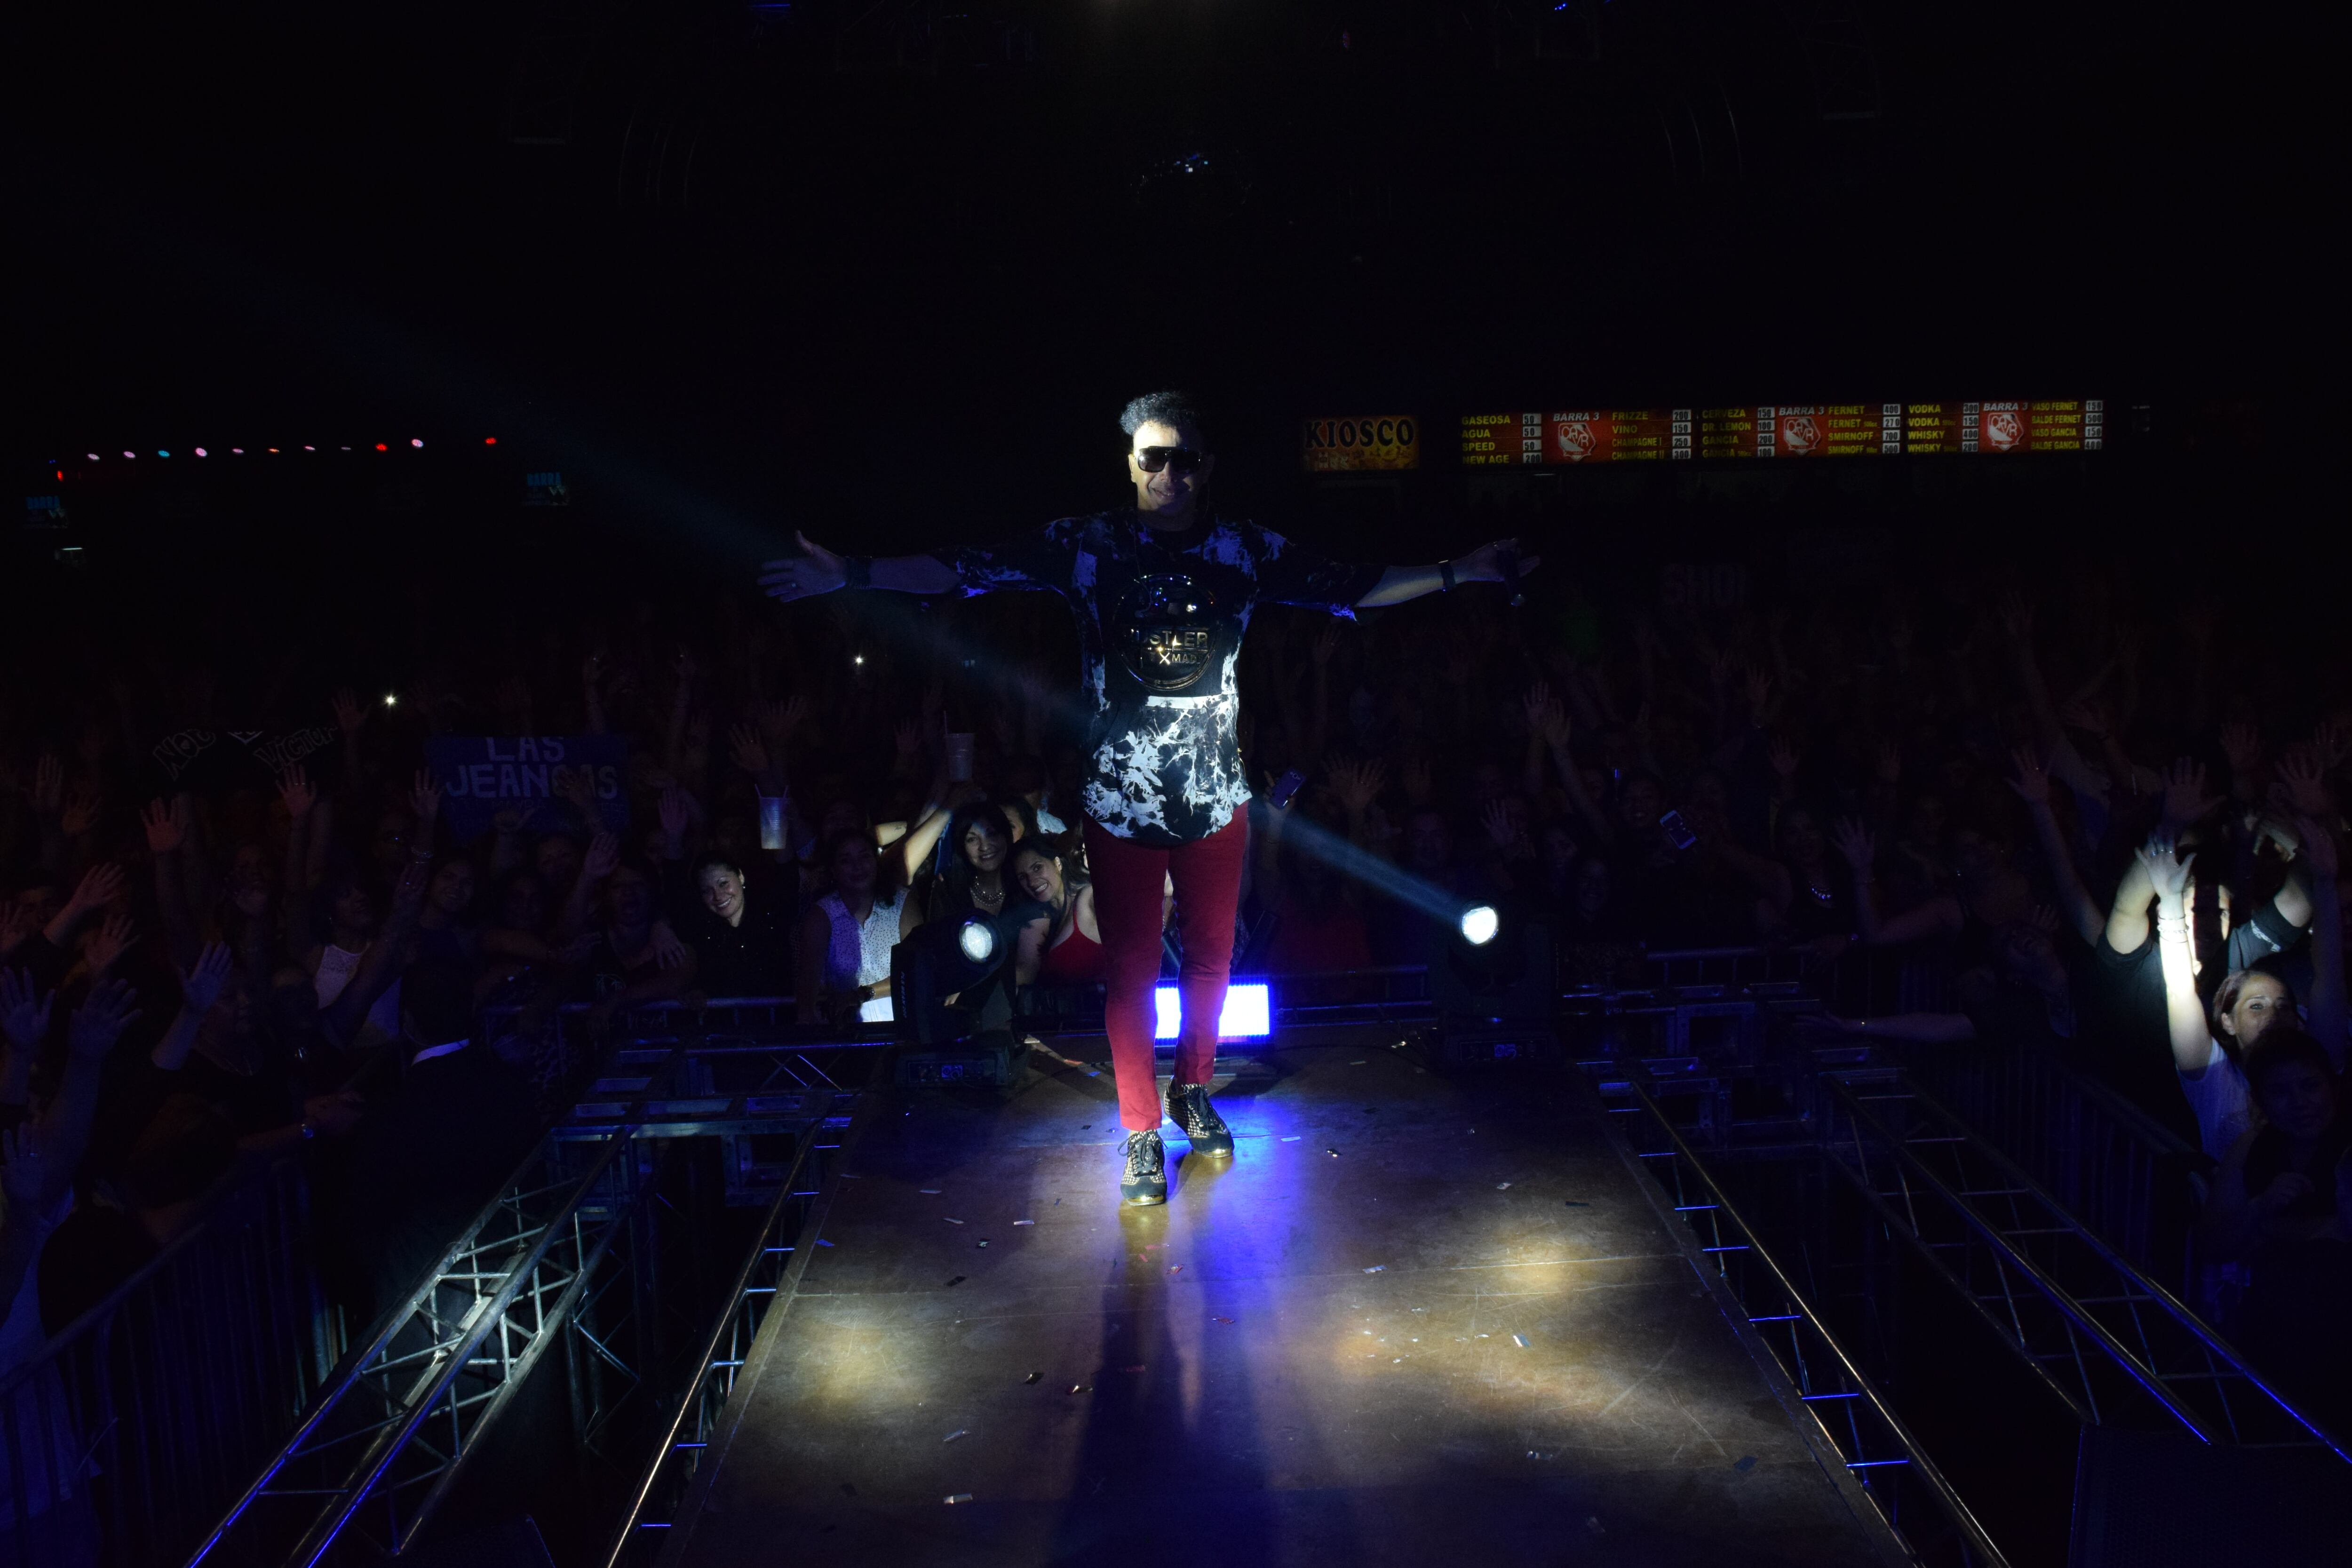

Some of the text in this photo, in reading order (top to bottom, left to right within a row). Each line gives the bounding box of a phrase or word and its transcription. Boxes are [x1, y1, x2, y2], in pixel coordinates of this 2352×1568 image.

[1828, 405, 1899, 415] FERNET 400
[1908, 404, 1941, 414] VODKA
[1984, 403, 2018, 411] BARRA
[2052, 401, 2078, 410] FERNET
[1702, 408, 1746, 418] CERVEZA
[1779, 407, 1814, 415] BARRA
[1462, 415, 1511, 425] GASEOSA
[1553, 413, 1589, 422] BARRA
[1612, 411, 1648, 421] FRIZZE
[2055, 414, 2082, 423] FERNET
[1720, 422, 1751, 431] LEMON
[1828, 419, 1861, 428] FERNET
[1908, 418, 1940, 427] VODKA
[1306, 419, 1413, 448] KIOSCO
[1462, 429, 1491, 438] AGUA
[1828, 432, 1874, 441] SMIRNOFF
[1907, 430, 1945, 439] WHISKY
[2051, 428, 2076, 437] GANCIA
[1612, 438, 1657, 446] CHAMPAGNE
[1702, 435, 1739, 445] GANCIA
[1462, 442, 1495, 451] SPEED
[1828, 445, 1864, 454] SMIRNOFF
[1884, 445, 1898, 453] 500
[1907, 444, 1941, 453] WHISKY
[2054, 441, 2080, 450] GANCIA
[1612, 451, 1658, 460] CHAMPAGNE
[1675, 450, 1689, 459] 300
[1702, 449, 1735, 458] GANCIA
[1462, 454, 1541, 464] NEW AGE 200
[485, 736, 565, 762] LAS
